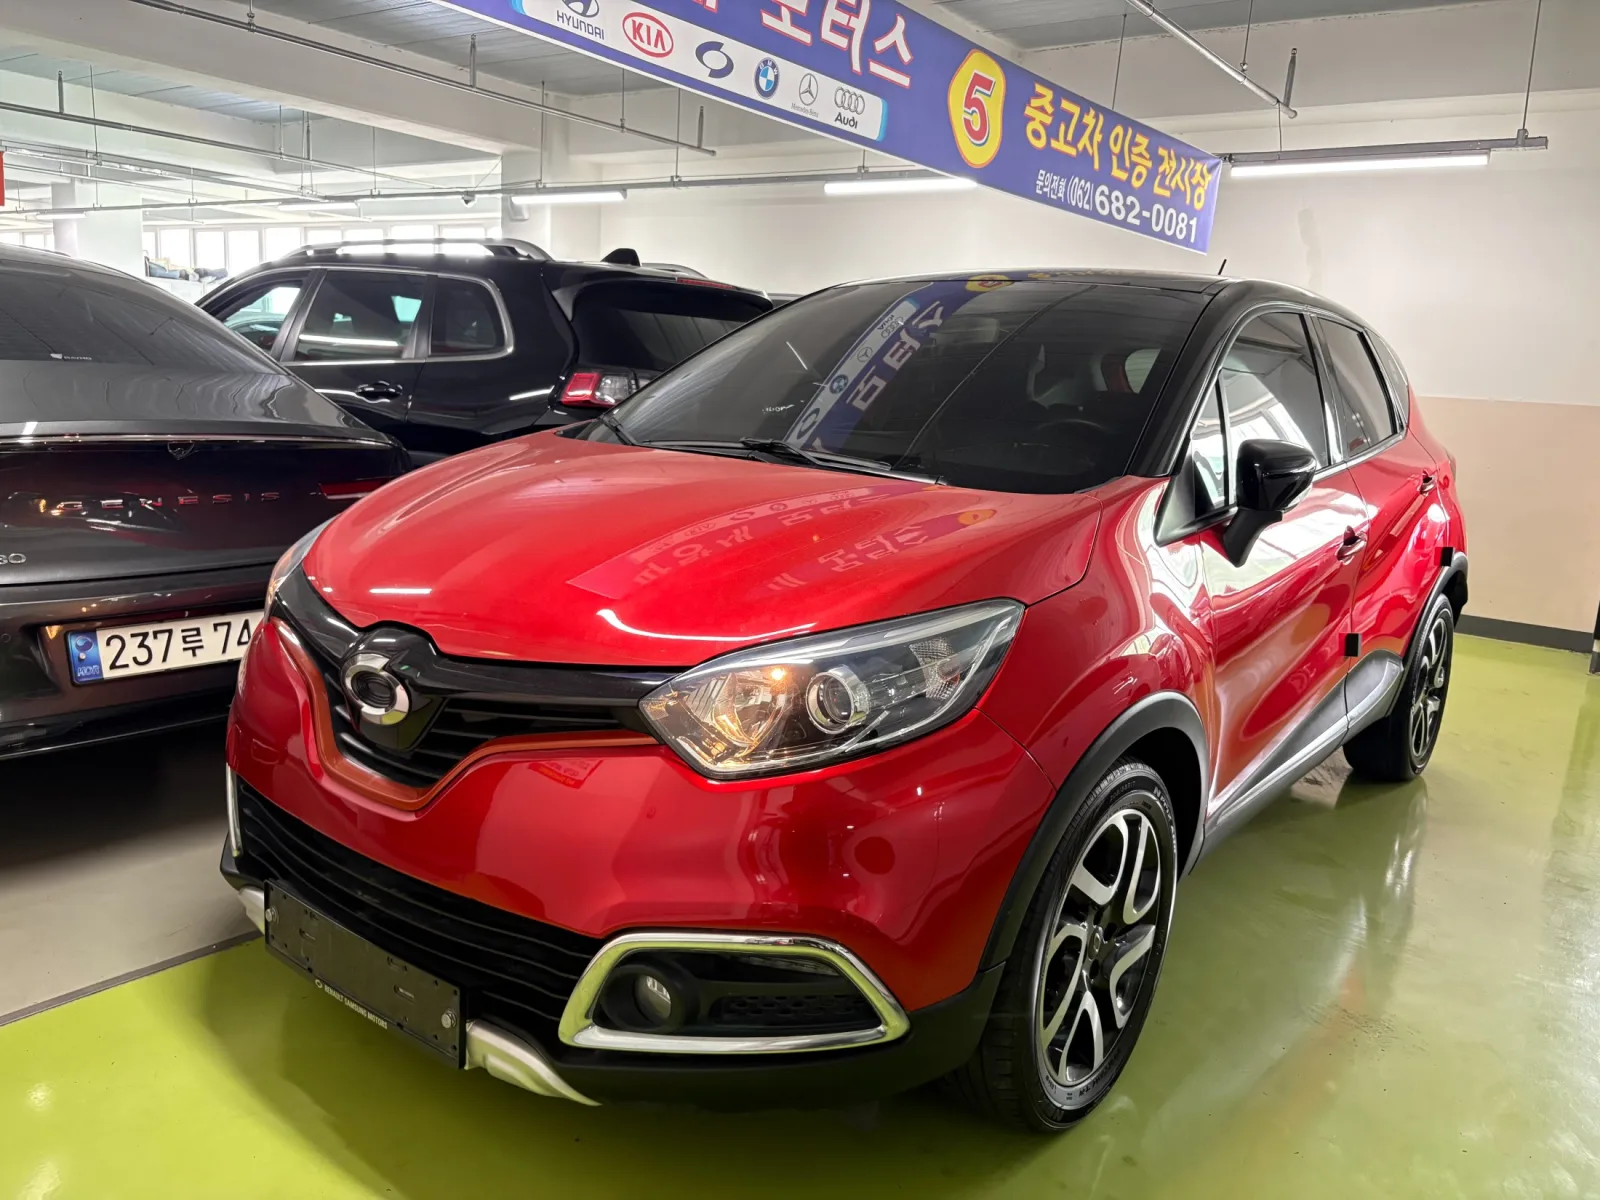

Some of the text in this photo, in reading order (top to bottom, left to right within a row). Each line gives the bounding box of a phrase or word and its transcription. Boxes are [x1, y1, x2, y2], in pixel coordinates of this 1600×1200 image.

[556, 10, 605, 40] HYUNDAI
[631, 19, 667, 52] KIA
[834, 112, 858, 129] Audi
[962, 69, 996, 147] 5
[1024, 82, 1212, 211] 중고차 인증 전시장
[1036, 169, 1068, 203] 문의전화
[57, 491, 281, 510] GENESIS
[105, 627, 204, 670] 237루
[77, 664, 101, 678] KOR
[344, 997, 367, 1018] SAMSUNG
[367, 1011, 388, 1030] MOTORS
